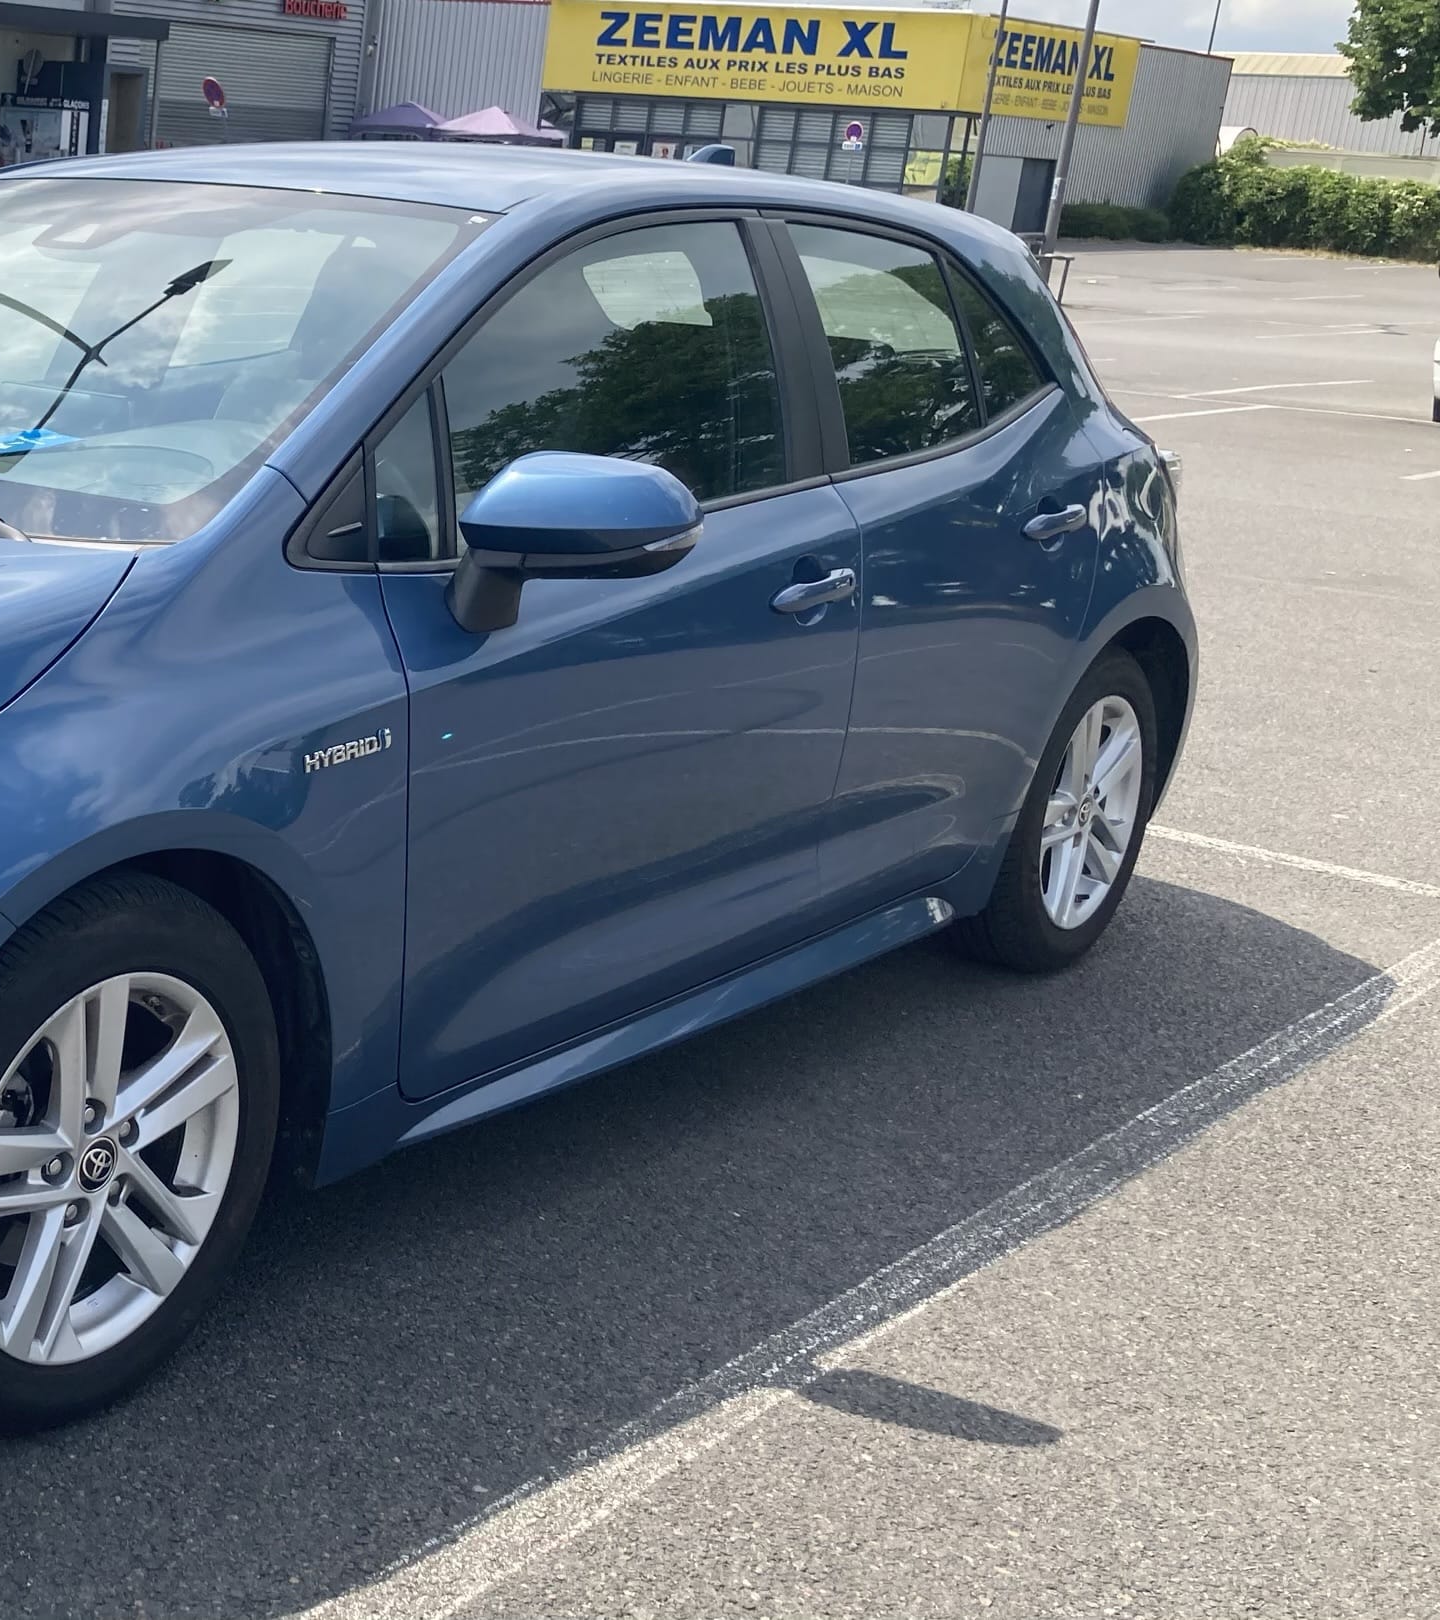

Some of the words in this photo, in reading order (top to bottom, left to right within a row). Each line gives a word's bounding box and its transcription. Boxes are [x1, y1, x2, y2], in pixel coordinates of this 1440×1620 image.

[285, 0, 347, 19] Boucherie
[596, 11, 821, 56] ZEEMAN
[836, 20, 908, 60] XL
[595, 53, 678, 68] TEXTILES
[684, 57, 721, 70] AUX
[726, 59, 768, 73] PRIX
[775, 62, 808, 75] LES
[814, 63, 862, 78] PLUS
[868, 66, 905, 79] BAS
[1088, 45, 1115, 82] XL
[592, 70, 653, 85] LINGERIE
[665, 74, 718, 88] ENFANT
[778, 80, 834, 94] JOUETS
[846, 83, 904, 97] MAISON
[1024, 78, 1041, 91] AUX
